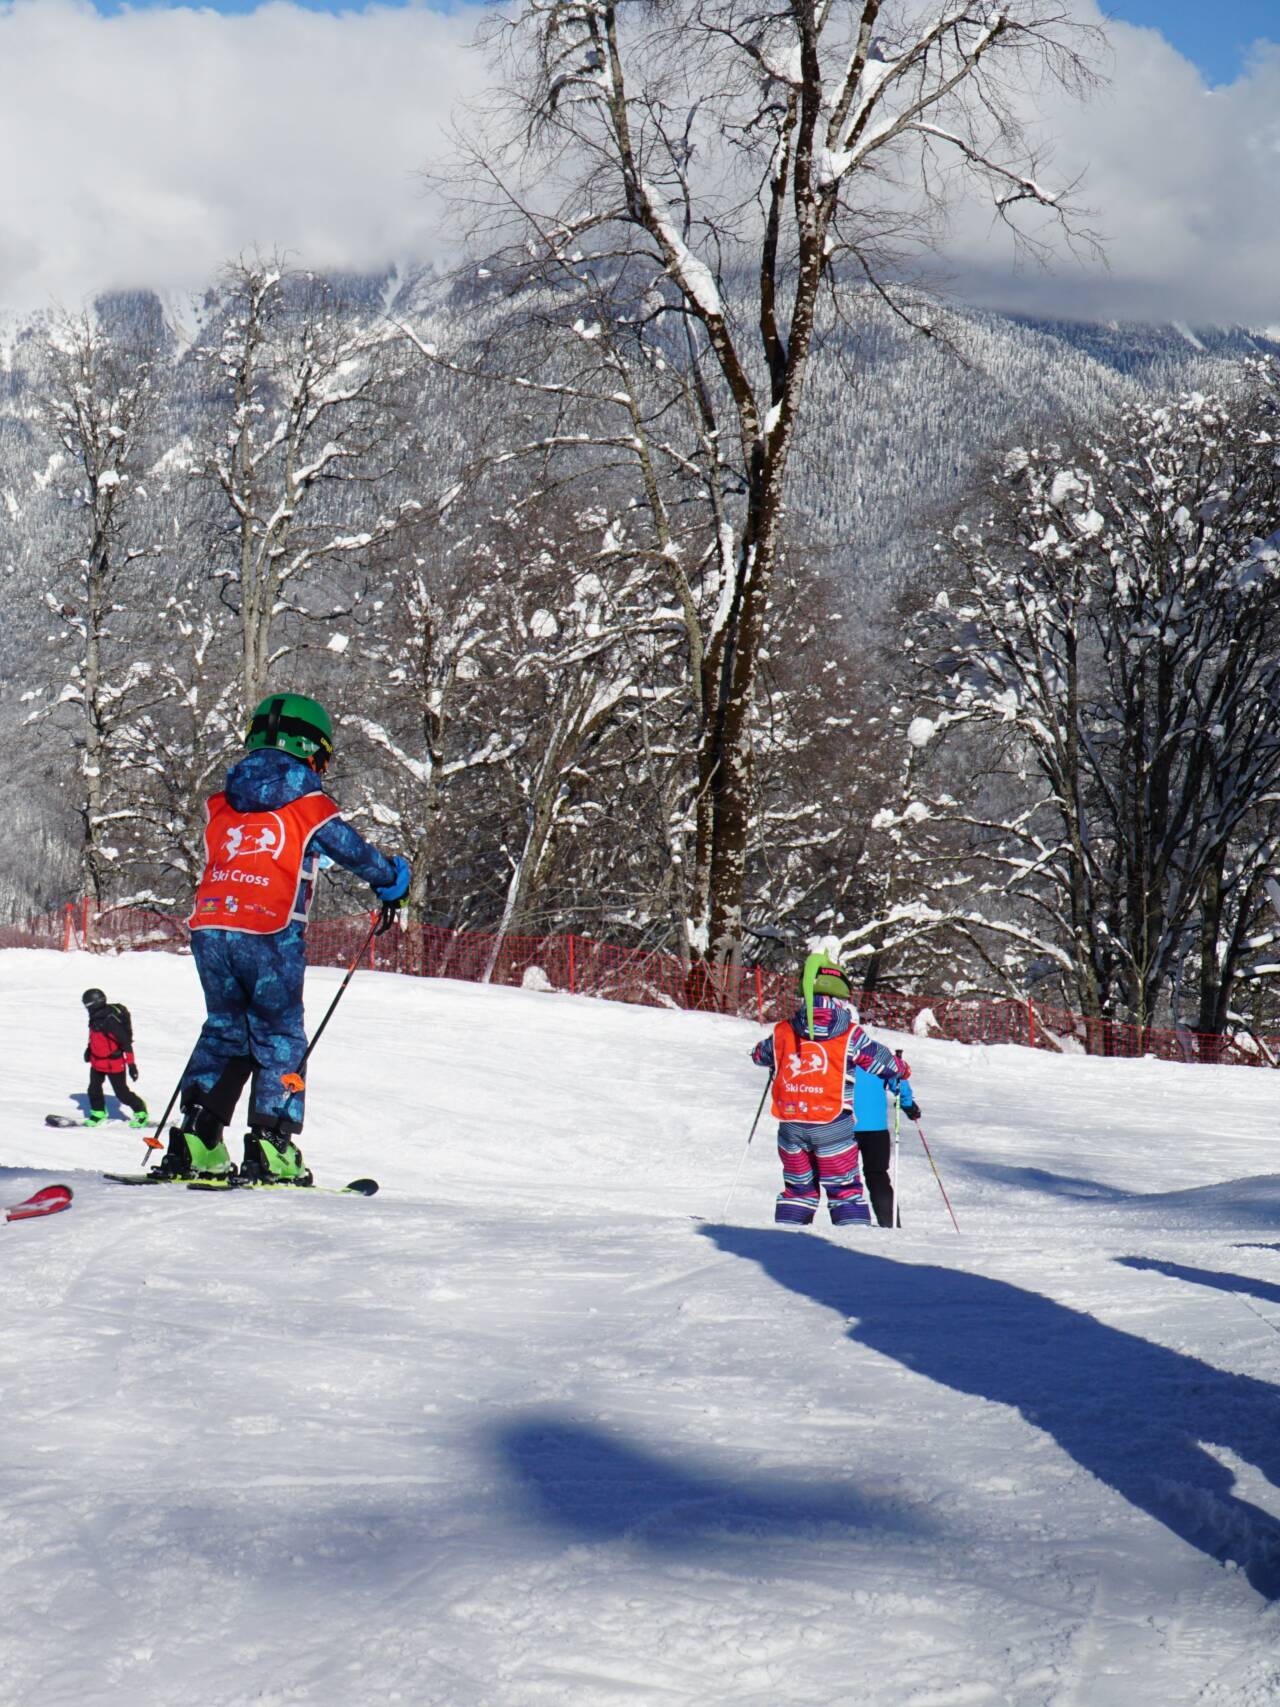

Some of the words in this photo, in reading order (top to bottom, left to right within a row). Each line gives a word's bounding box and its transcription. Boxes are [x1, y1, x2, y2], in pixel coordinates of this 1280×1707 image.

[211, 869, 230, 882] Ski
[231, 869, 270, 887] Cross
[785, 1083, 799, 1093] Ski
[799, 1083, 824, 1094] Cross
